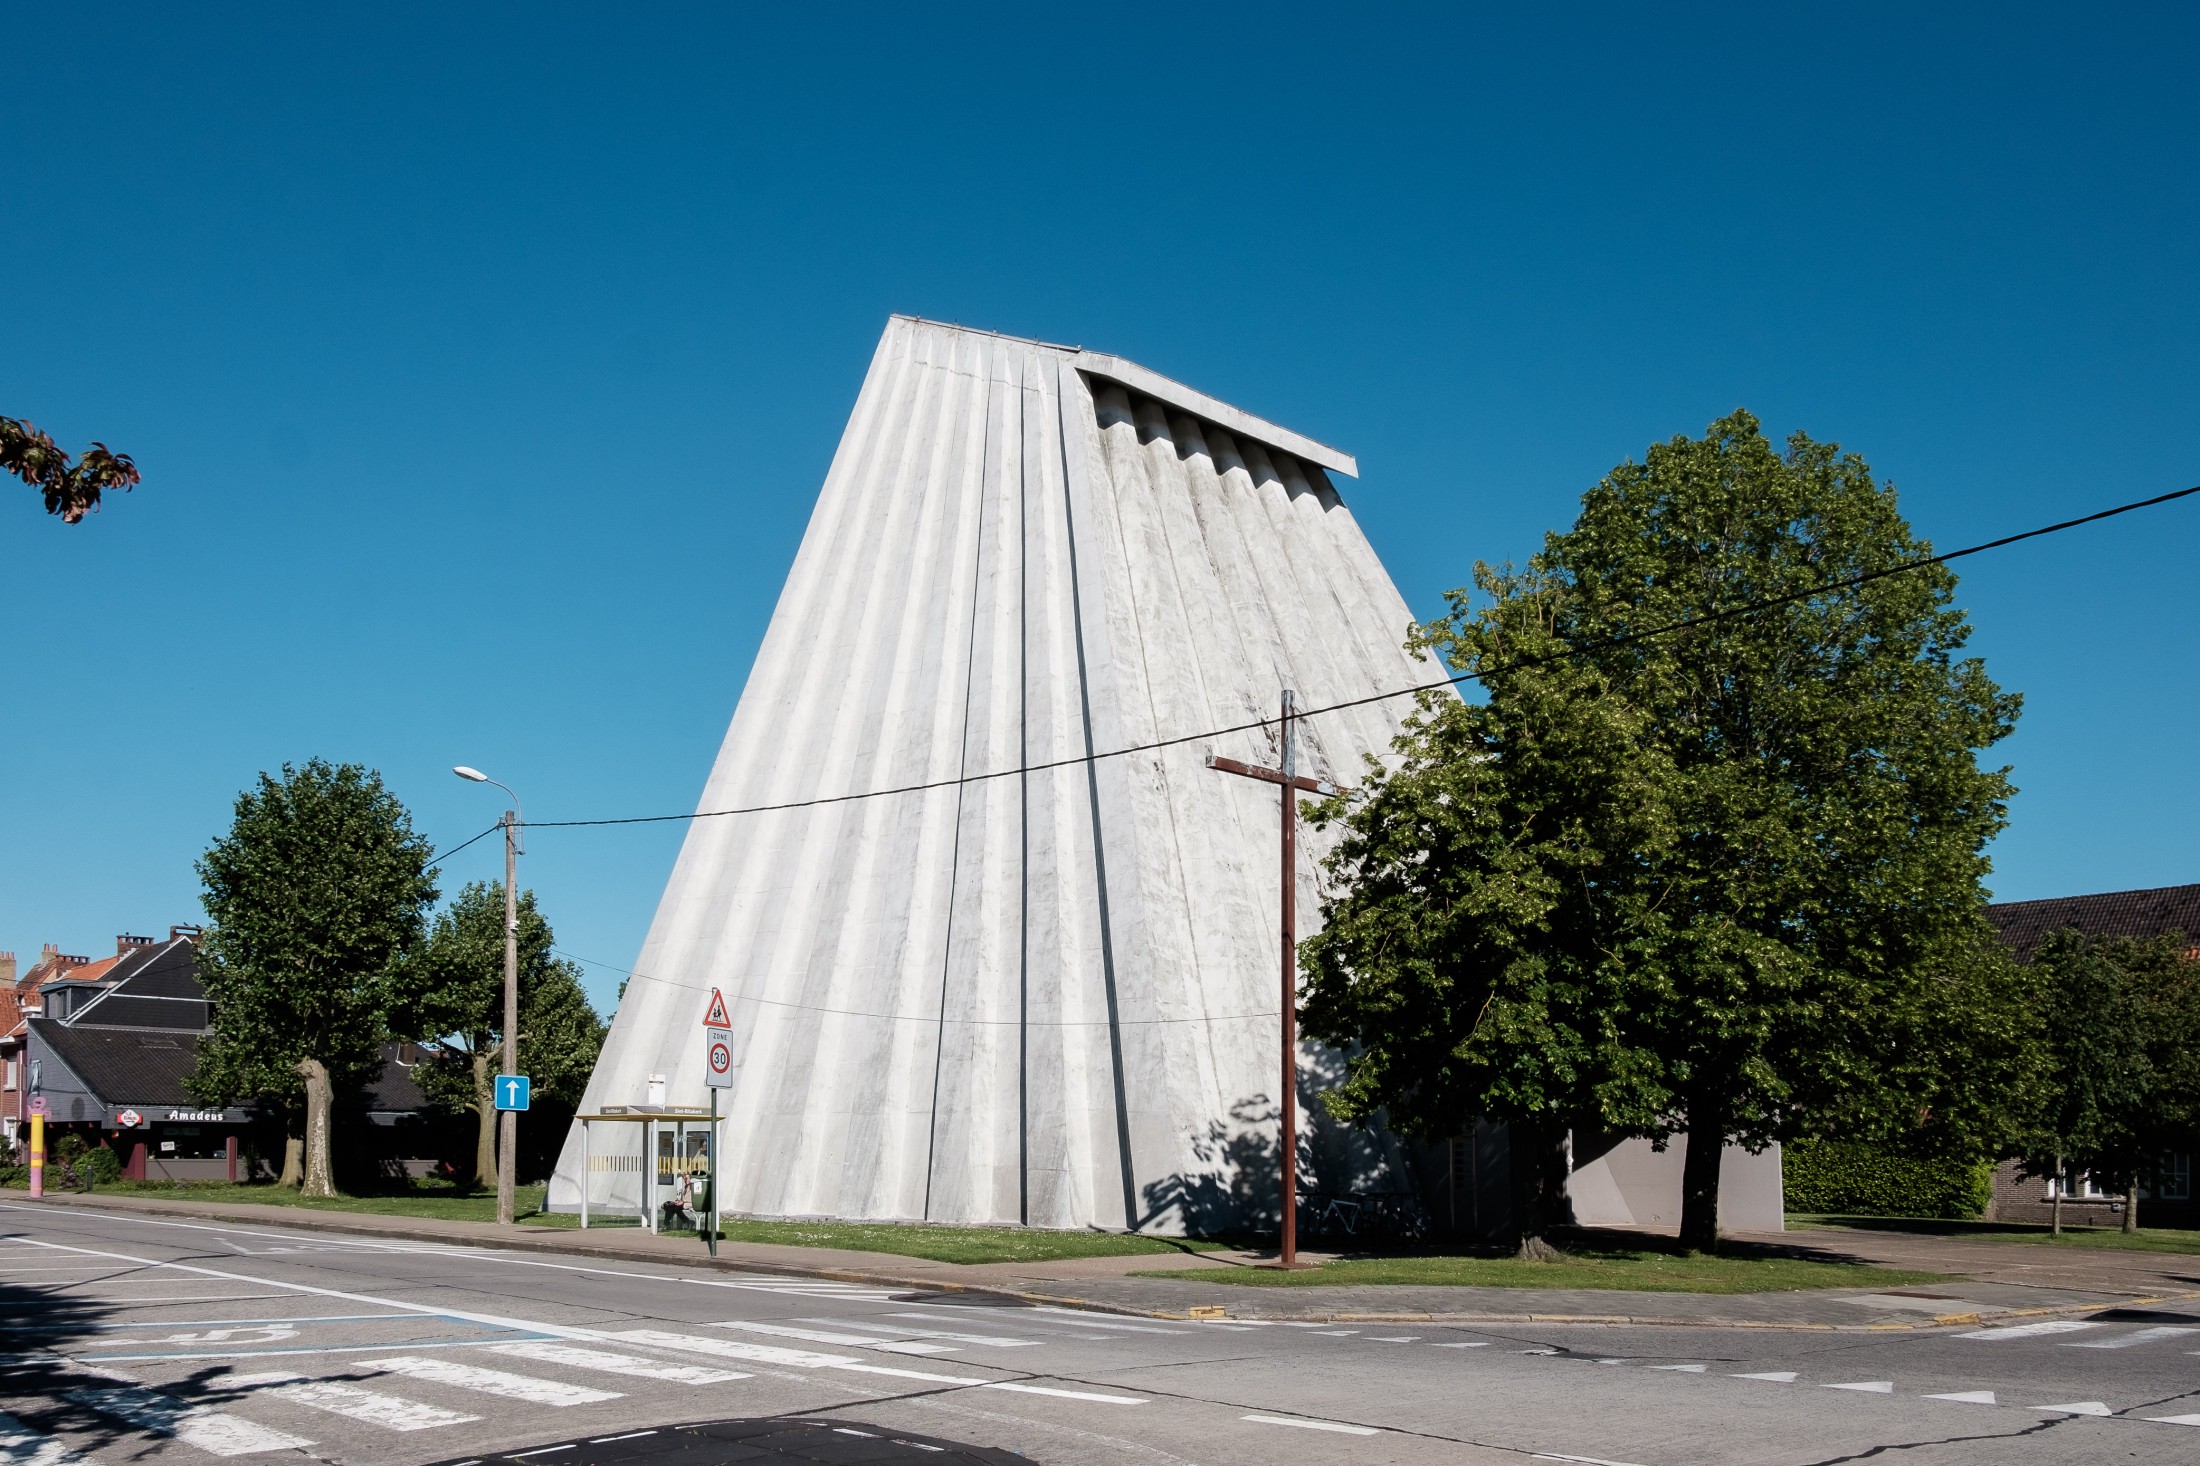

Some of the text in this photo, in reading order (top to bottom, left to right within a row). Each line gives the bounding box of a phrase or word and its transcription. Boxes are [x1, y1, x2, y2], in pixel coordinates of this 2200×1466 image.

[713, 1033, 728, 1041] ZONE
[713, 1052, 726, 1065] 30
[169, 1110, 224, 1121] Amadeus
